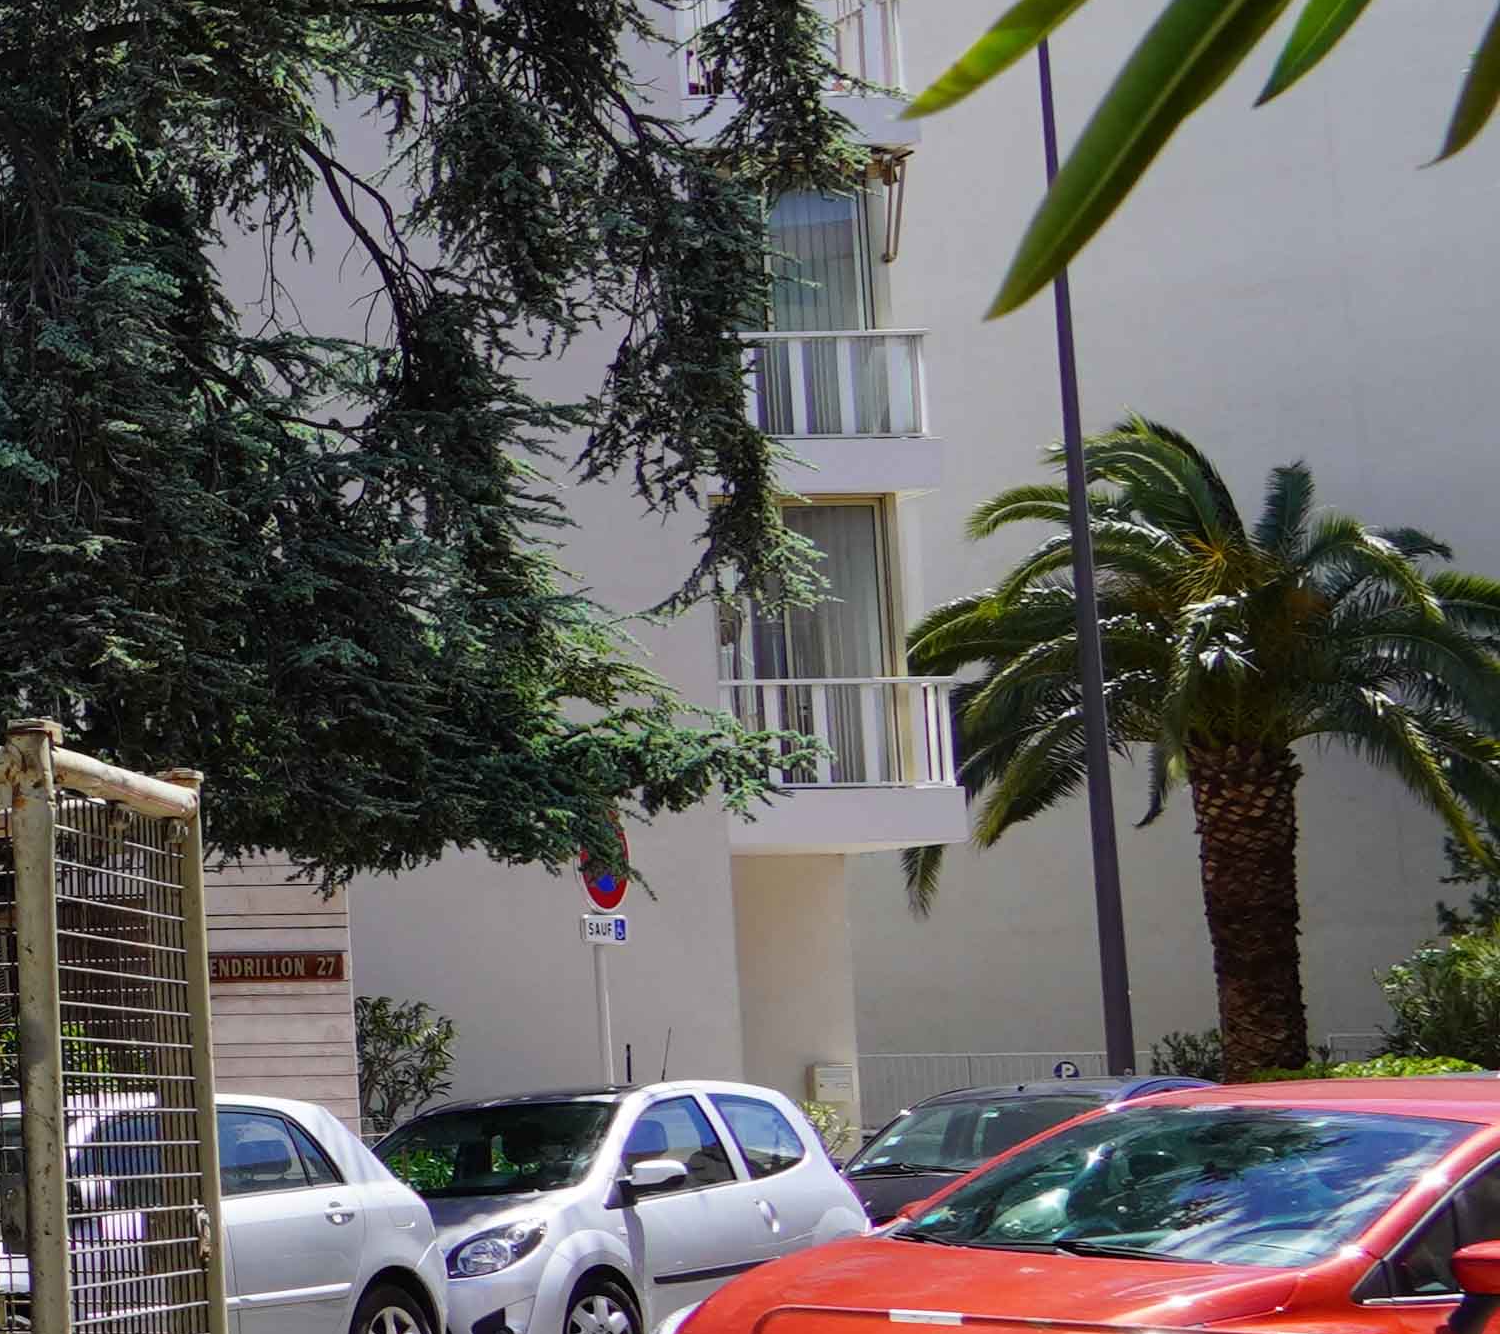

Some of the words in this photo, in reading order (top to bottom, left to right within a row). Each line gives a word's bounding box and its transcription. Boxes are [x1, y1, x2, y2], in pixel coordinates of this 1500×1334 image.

[588, 922, 613, 936] SAUF
[209, 957, 306, 978] ENDRILLON
[316, 957, 335, 976] 27
